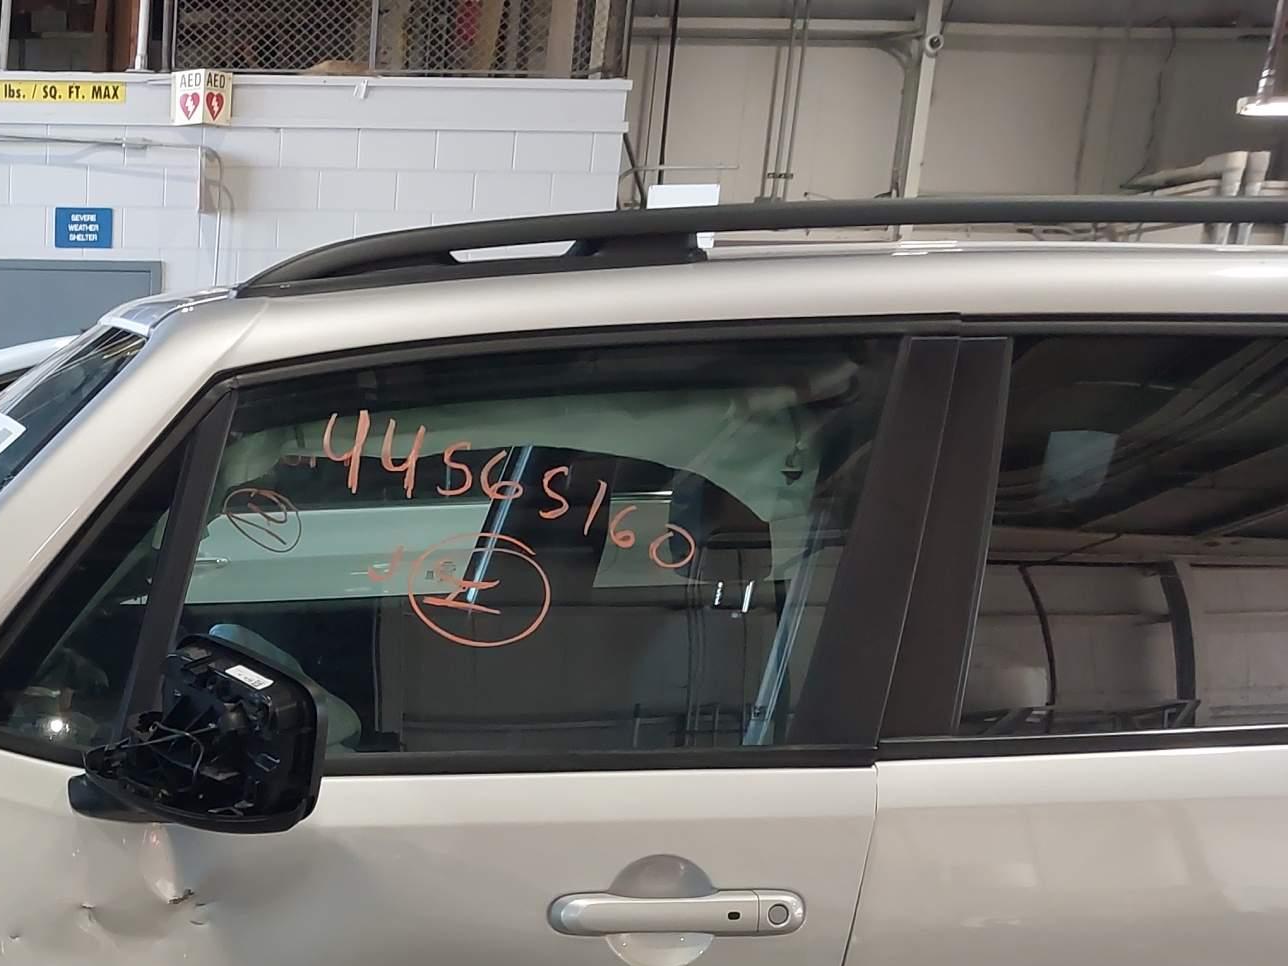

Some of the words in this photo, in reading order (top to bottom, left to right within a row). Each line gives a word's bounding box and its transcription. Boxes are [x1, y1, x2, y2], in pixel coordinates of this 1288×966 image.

[179, 72, 201, 88] AED
[206, 72, 226, 89] AED
[4, 84, 26, 99] lbs.
[31, 84, 37, 99] /
[42, 85, 62, 101] SQ.
[68, 85, 85, 100] FT.
[91, 85, 120, 100] MAX
[68, 223, 99, 232] WEATHER
[69, 233, 98, 242] SHELTER
[322, 408, 696, 568] 44565160
